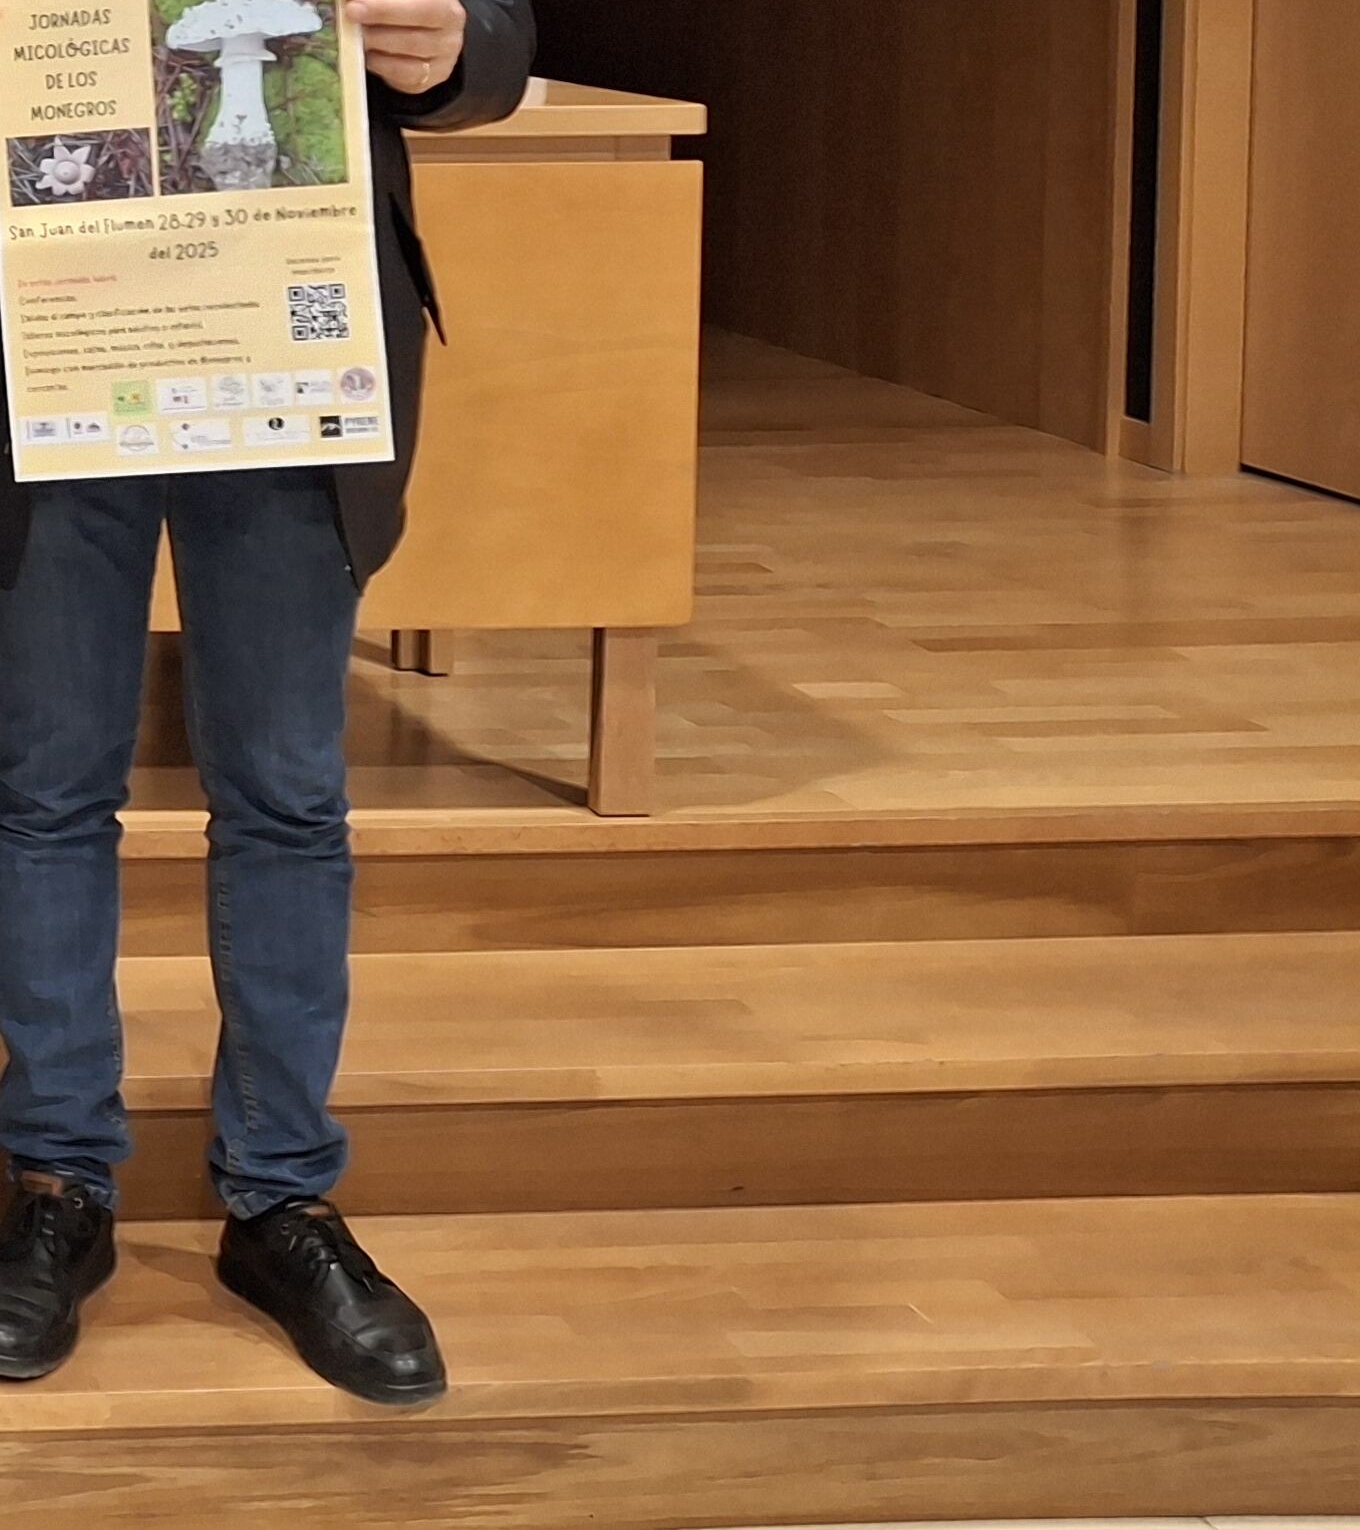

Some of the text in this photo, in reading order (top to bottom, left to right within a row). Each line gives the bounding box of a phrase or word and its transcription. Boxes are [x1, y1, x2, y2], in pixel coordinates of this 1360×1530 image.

[28, 8, 111, 30] JORNADAS
[45, 70, 97, 90] DE LOS
[30, 99, 116, 121] MONEGROS
[8, 225, 34, 240] San
[39, 222, 74, 239] Juan
[78, 220, 100, 234] del
[103, 218, 155, 234] Flumen
[224, 209, 248, 226] 30
[252, 209, 271, 221] de
[275, 204, 356, 221] Noviembre
[148, 240, 218, 260] del 2025
